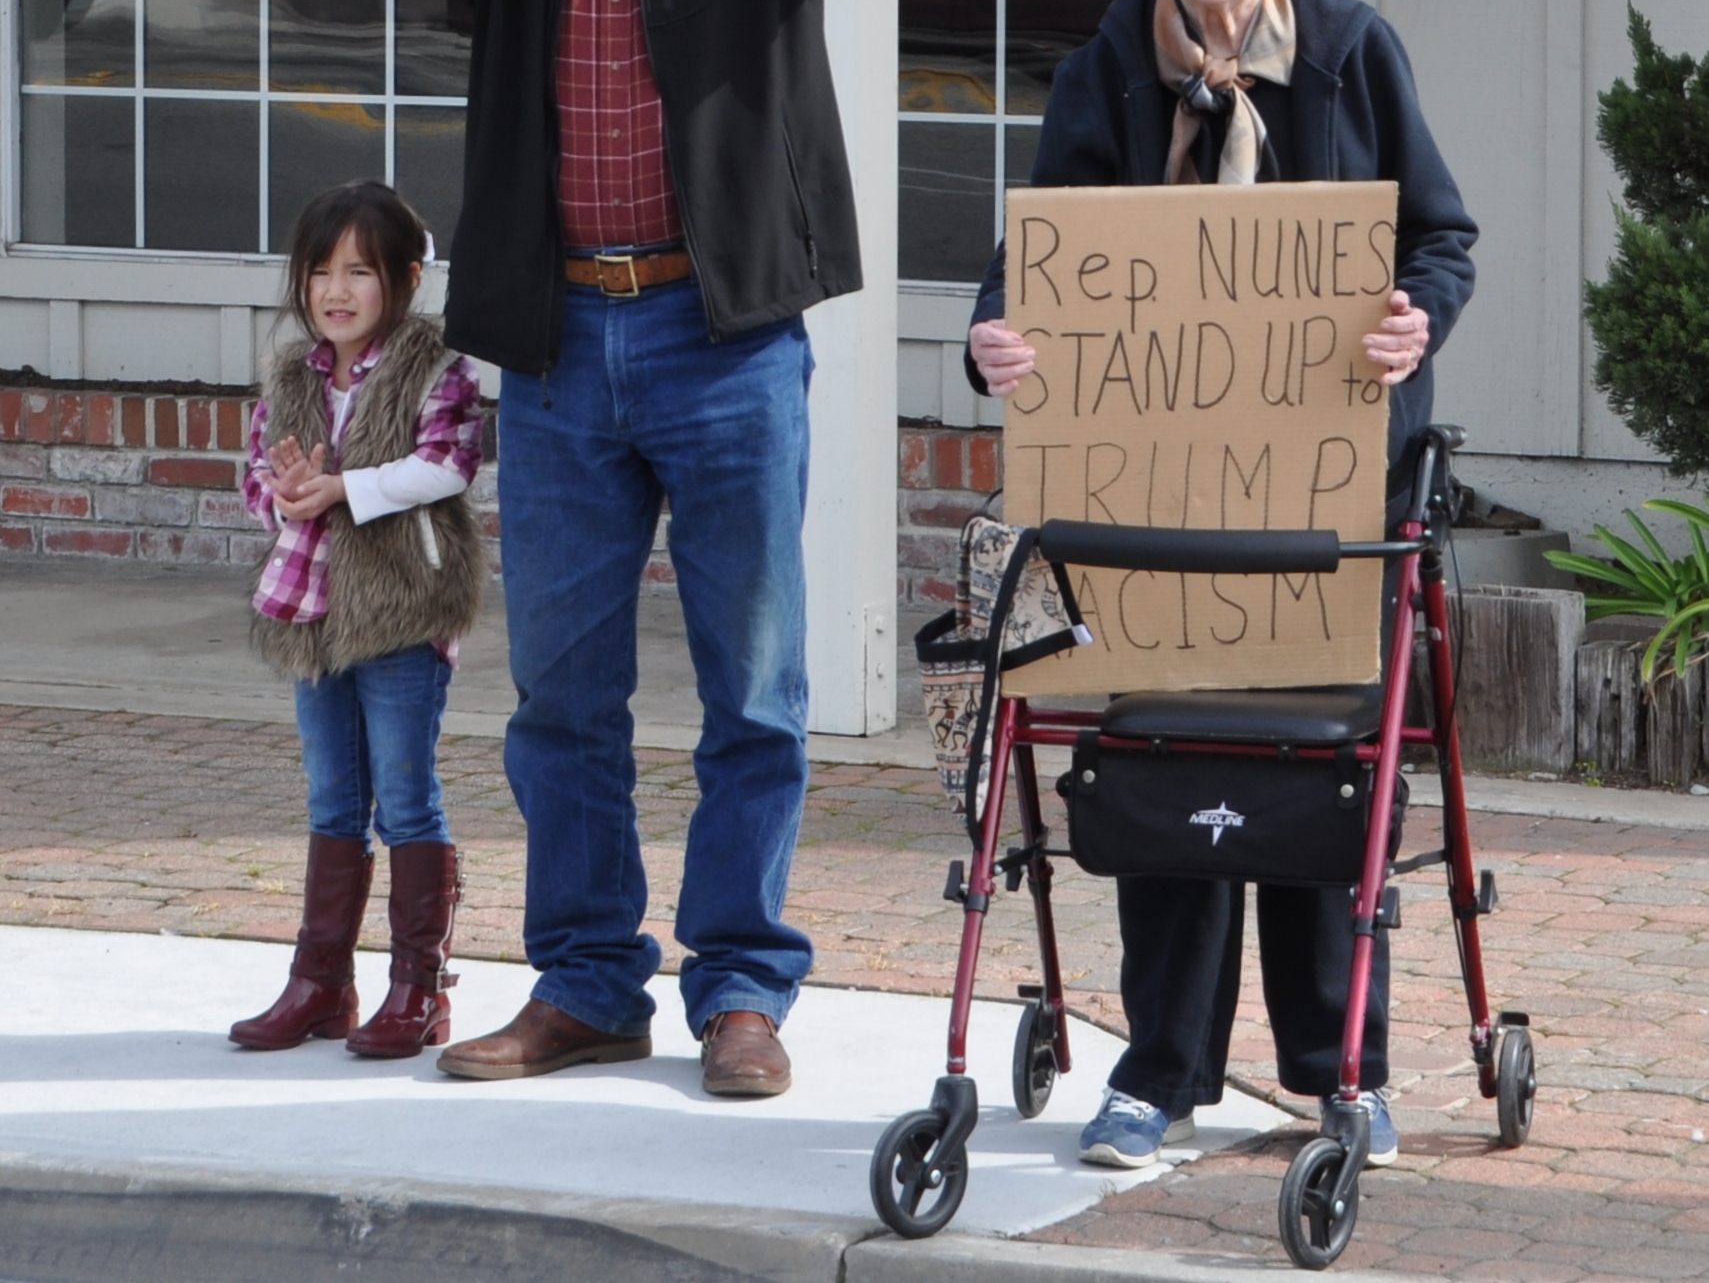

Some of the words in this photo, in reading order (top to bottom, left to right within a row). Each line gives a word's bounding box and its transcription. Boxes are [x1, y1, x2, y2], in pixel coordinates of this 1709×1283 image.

[1199, 216, 1396, 302] NUNES
[1012, 321, 1236, 416] STAND
[1261, 316, 1338, 408] UP
[1341, 361, 1384, 407] to
[1015, 437, 1358, 531] TRUMP
[1053, 569, 1332, 659] ACISM
[1189, 813, 1246, 827] MEDLINE
